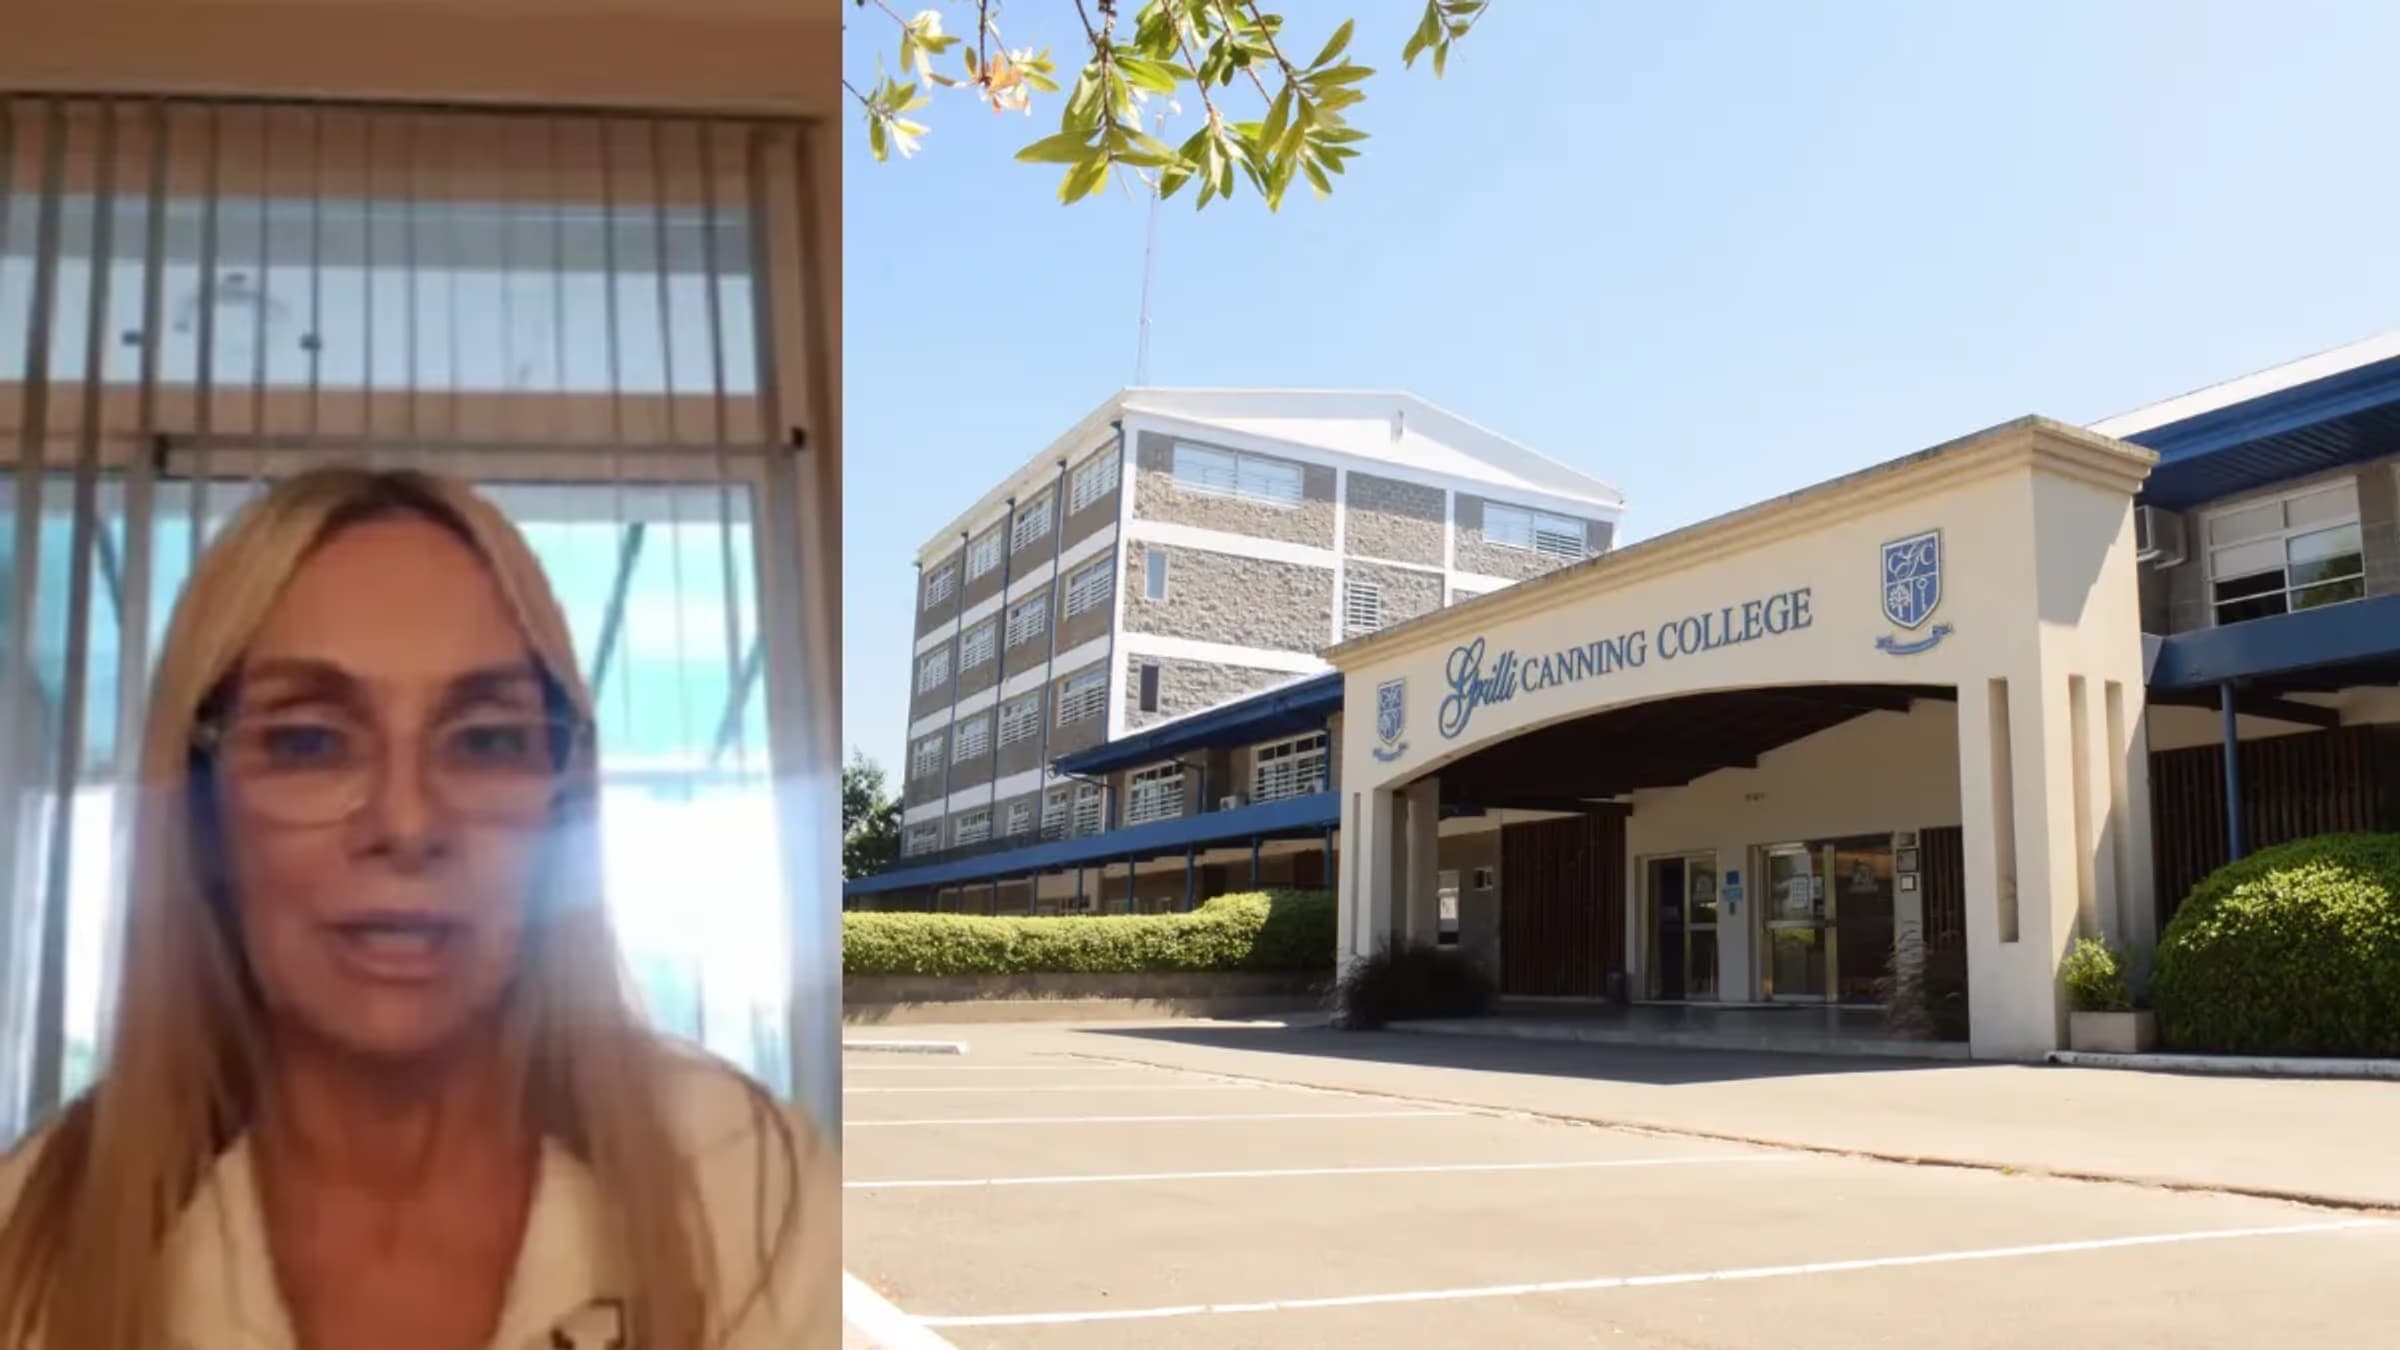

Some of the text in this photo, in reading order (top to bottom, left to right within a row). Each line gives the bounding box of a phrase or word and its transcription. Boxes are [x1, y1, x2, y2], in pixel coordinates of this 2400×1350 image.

[1438, 587, 1813, 739] Grilli CANNING COLLEGE
